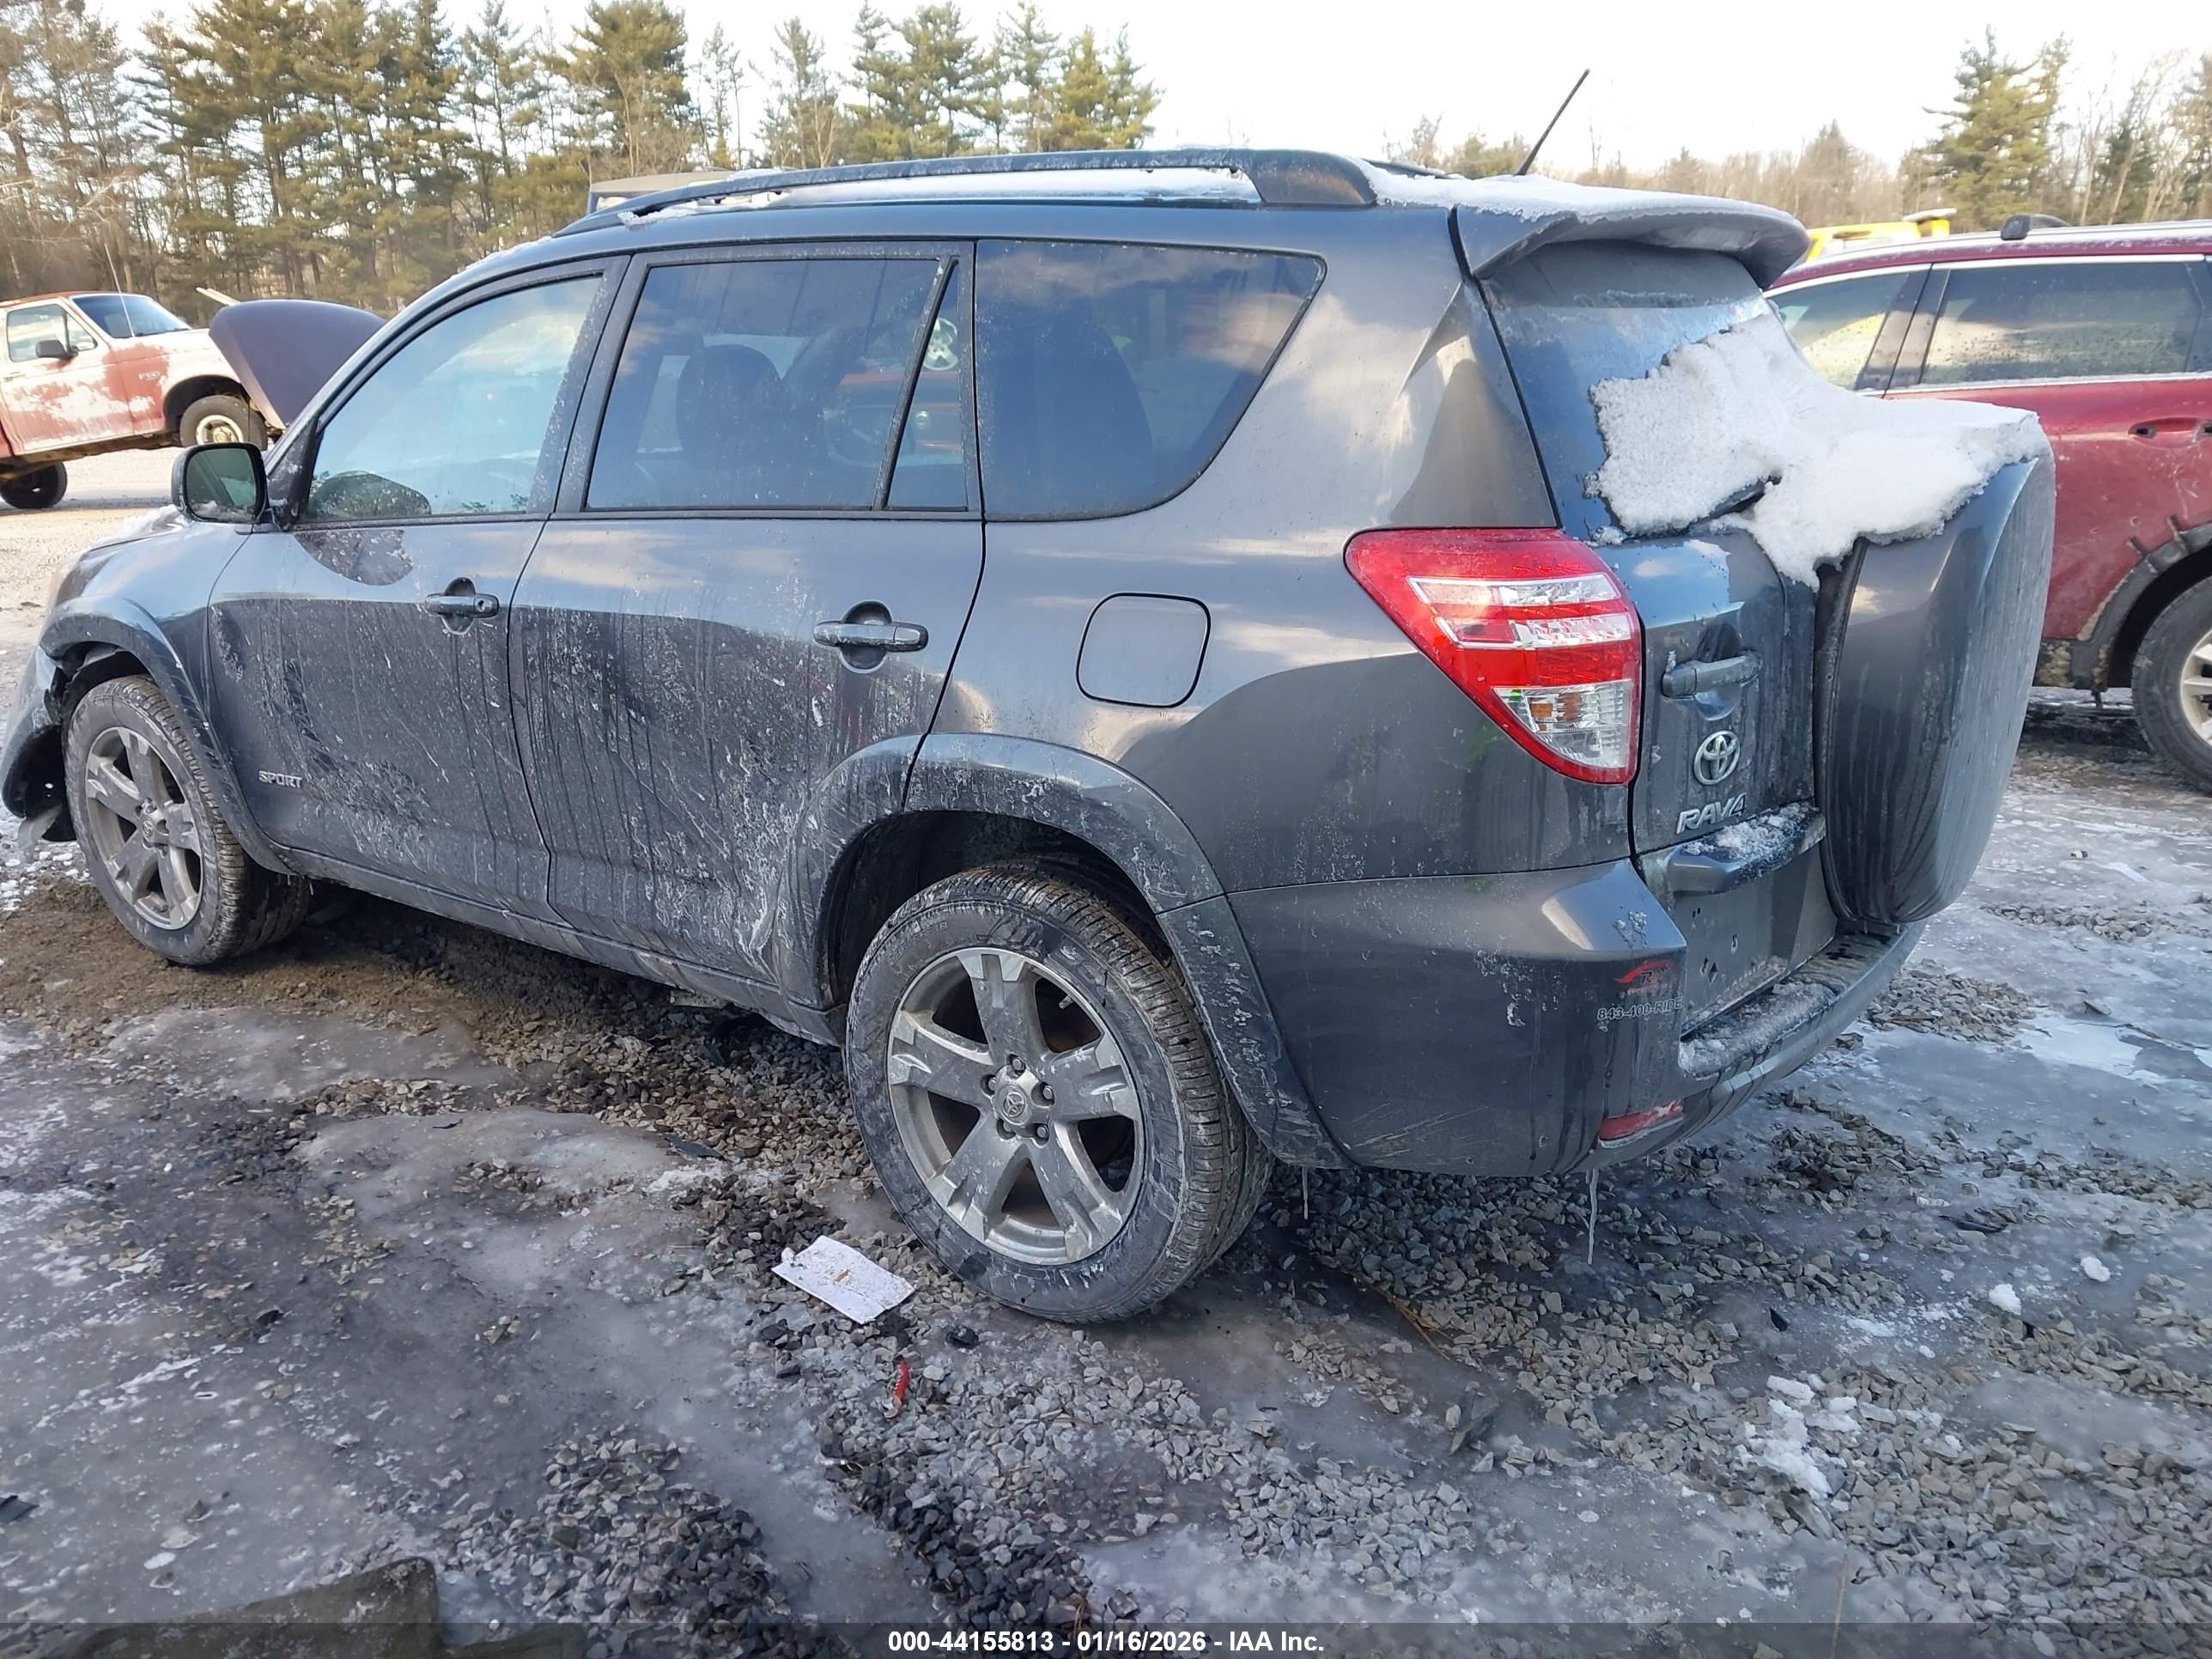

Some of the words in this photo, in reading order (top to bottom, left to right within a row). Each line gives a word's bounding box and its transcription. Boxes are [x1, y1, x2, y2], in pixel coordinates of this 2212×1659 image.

[258, 769, 302, 788] SPORT
[1675, 792, 1747, 835] RAV4
[1596, 996, 1684, 1020] 843-400-RIDE
